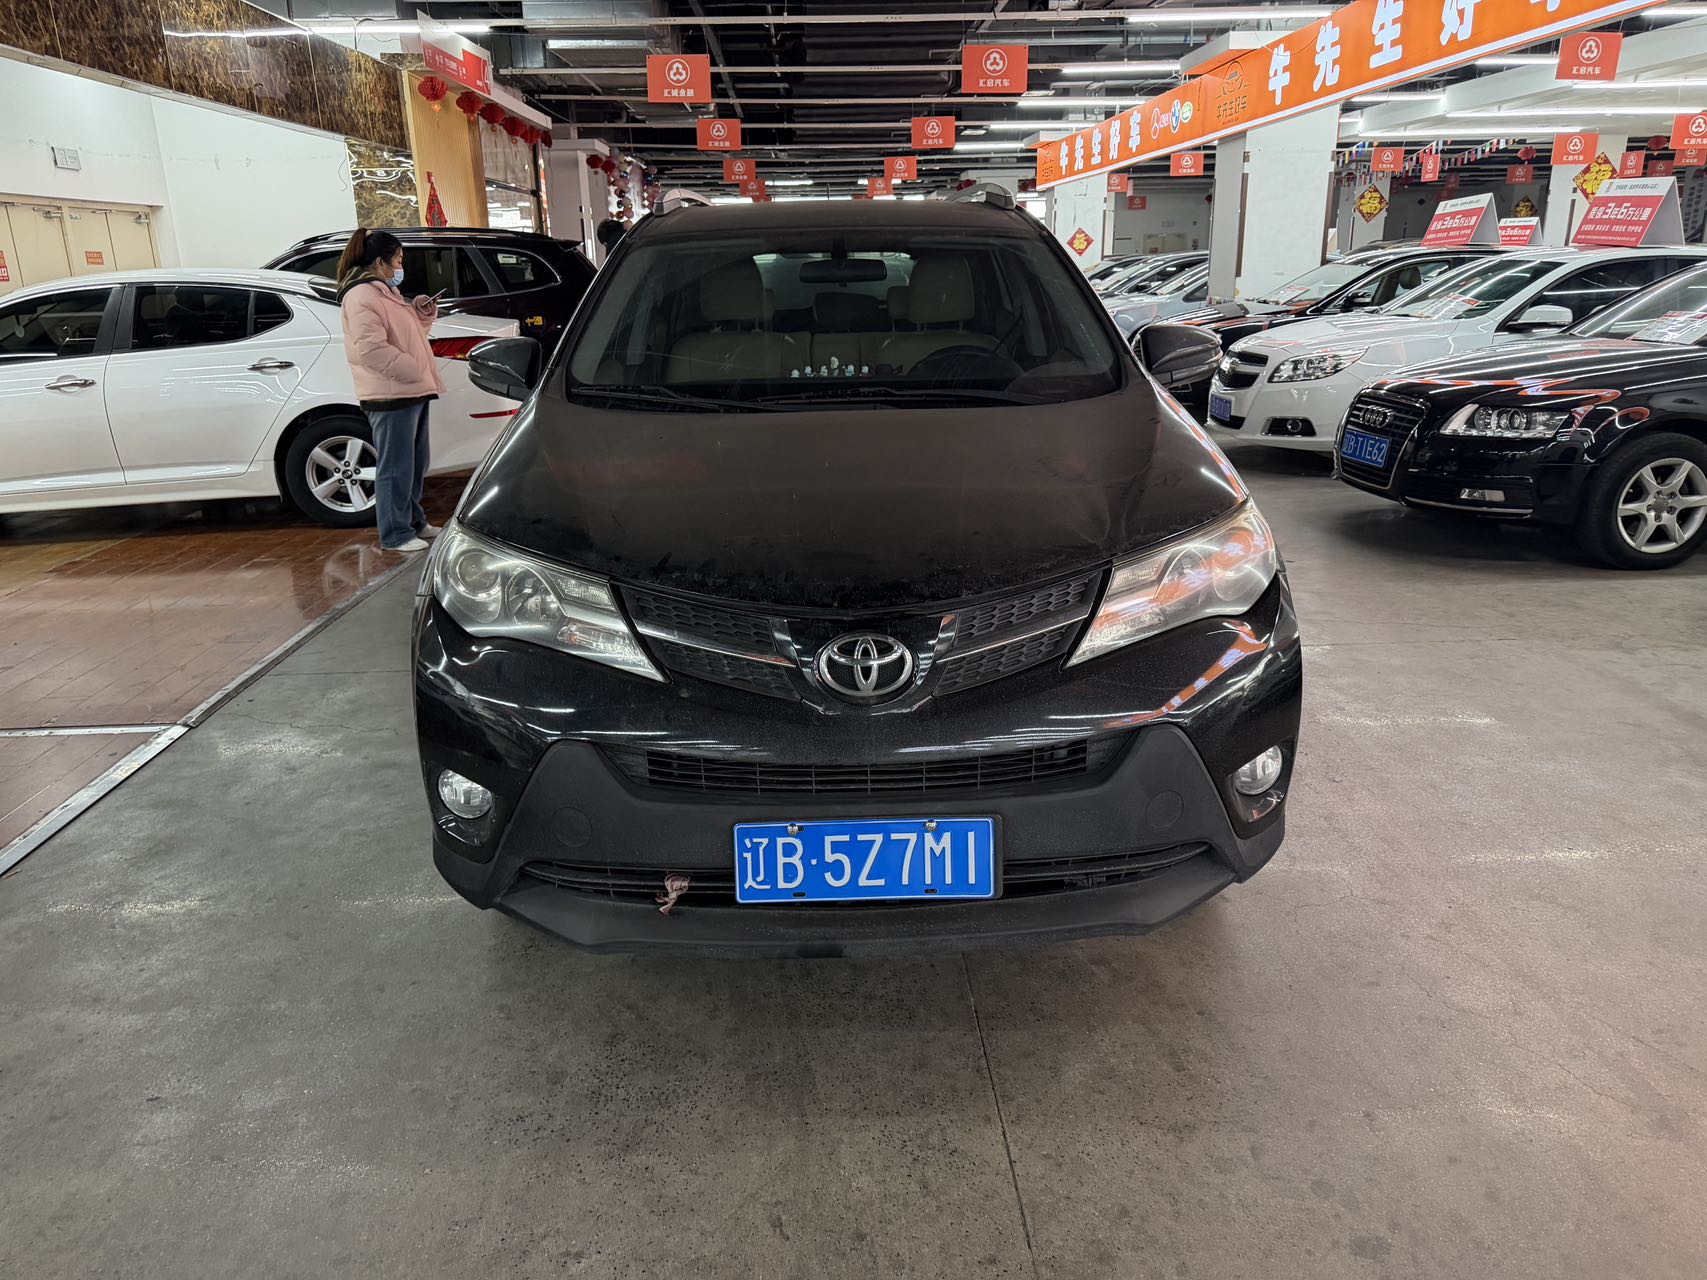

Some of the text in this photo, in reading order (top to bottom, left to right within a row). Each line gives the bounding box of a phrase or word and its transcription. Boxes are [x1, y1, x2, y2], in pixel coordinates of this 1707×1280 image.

[1268, 0, 1565, 105] 牛先生好
[1059, 109, 1141, 176] 牛先生好车
[743, 831, 976, 890] 辽B·5Z7M1
